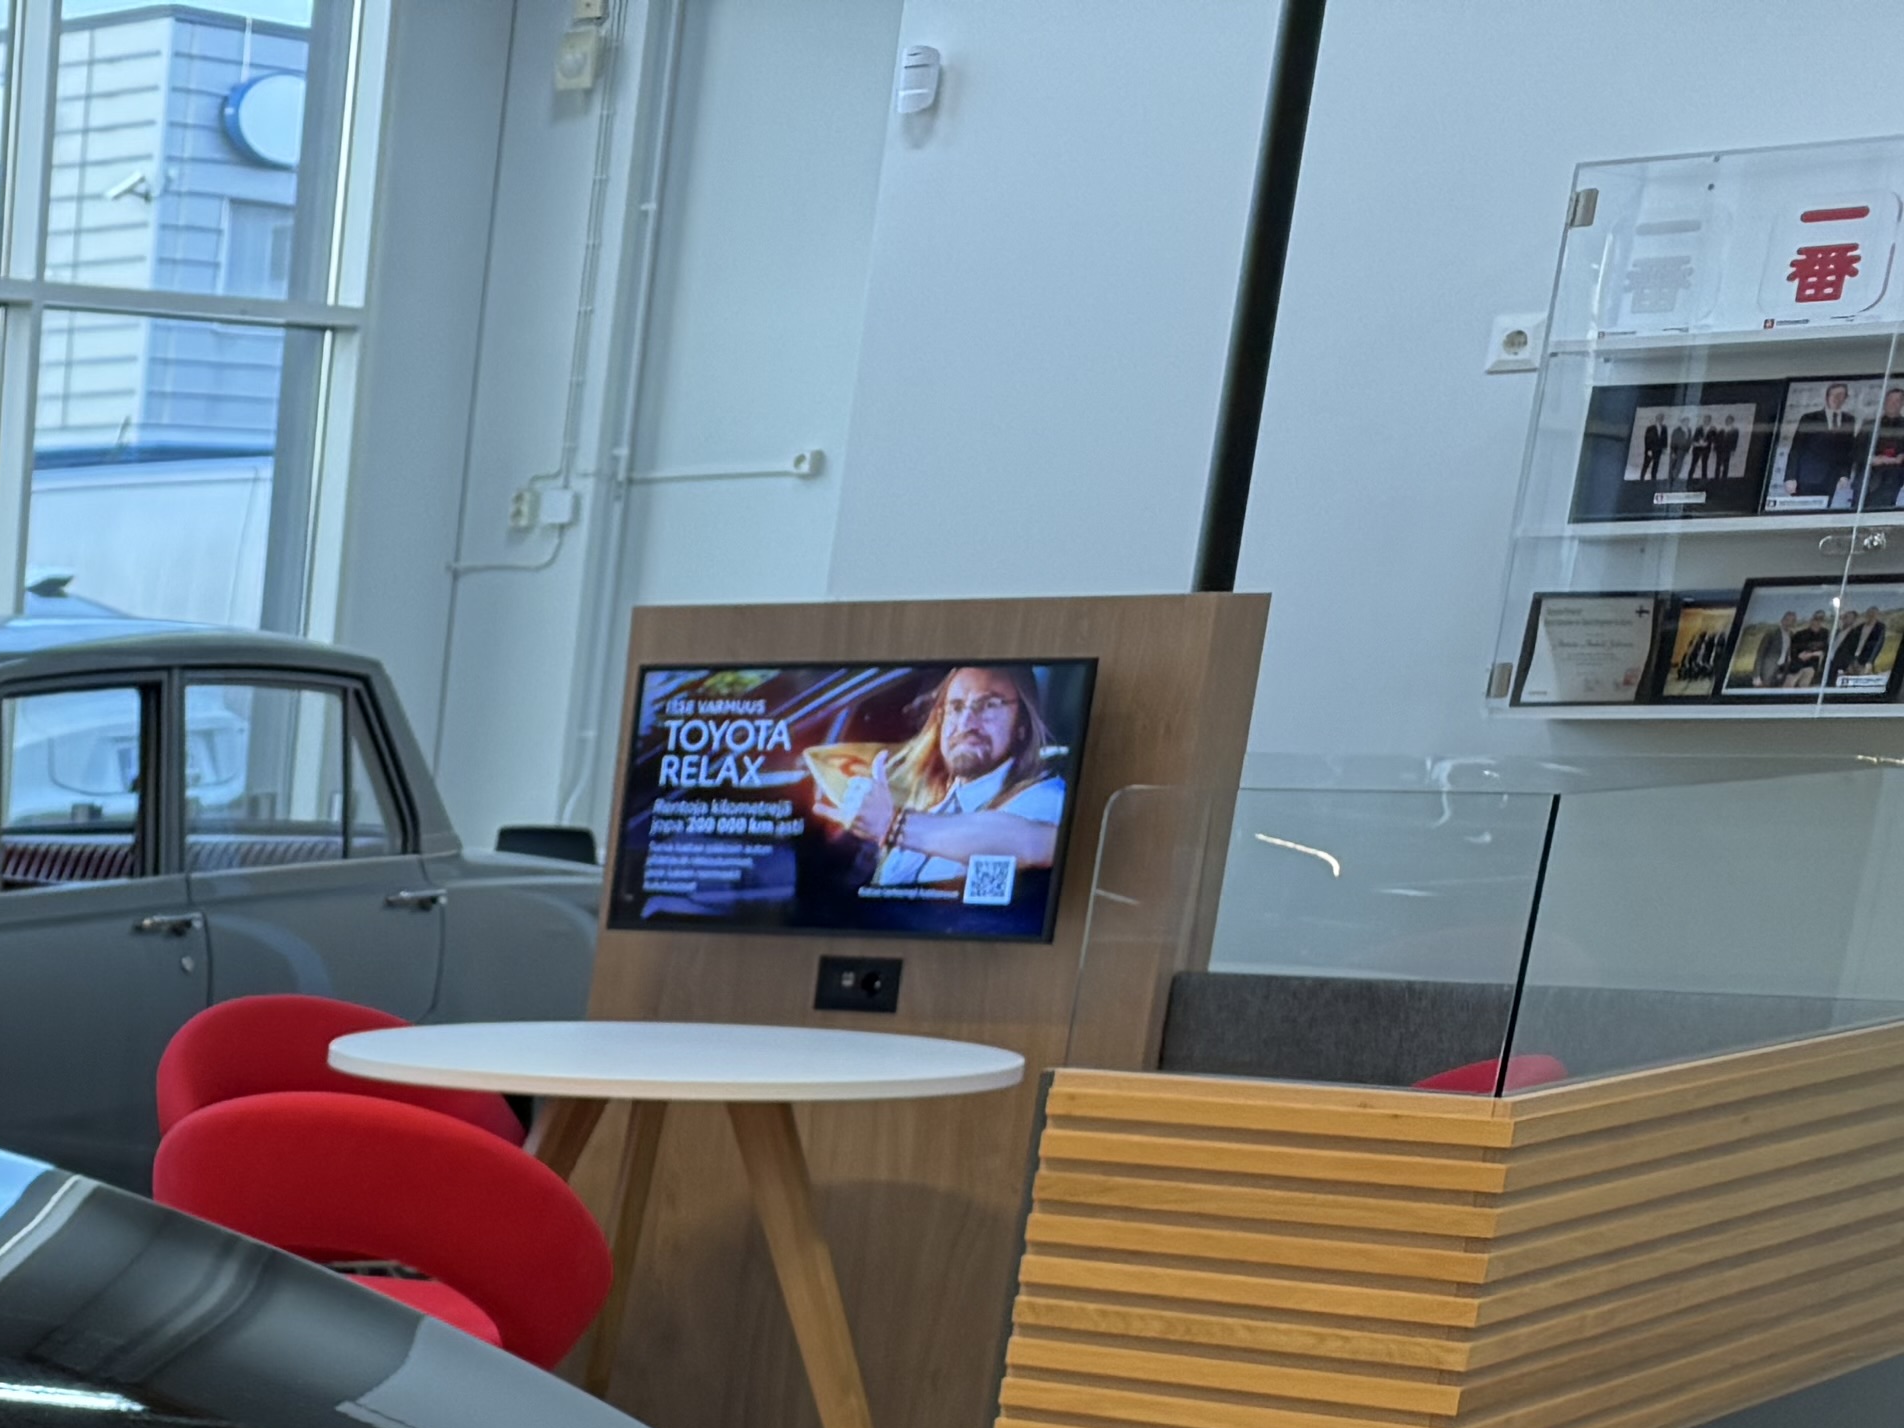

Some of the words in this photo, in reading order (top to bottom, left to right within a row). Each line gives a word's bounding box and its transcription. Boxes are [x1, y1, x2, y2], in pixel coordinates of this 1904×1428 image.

[1786, 205, 1870, 303] 一番
[663, 718, 792, 752] TOYOTA
[658, 753, 766, 787] RELAX
[748, 816, 775, 835] km
